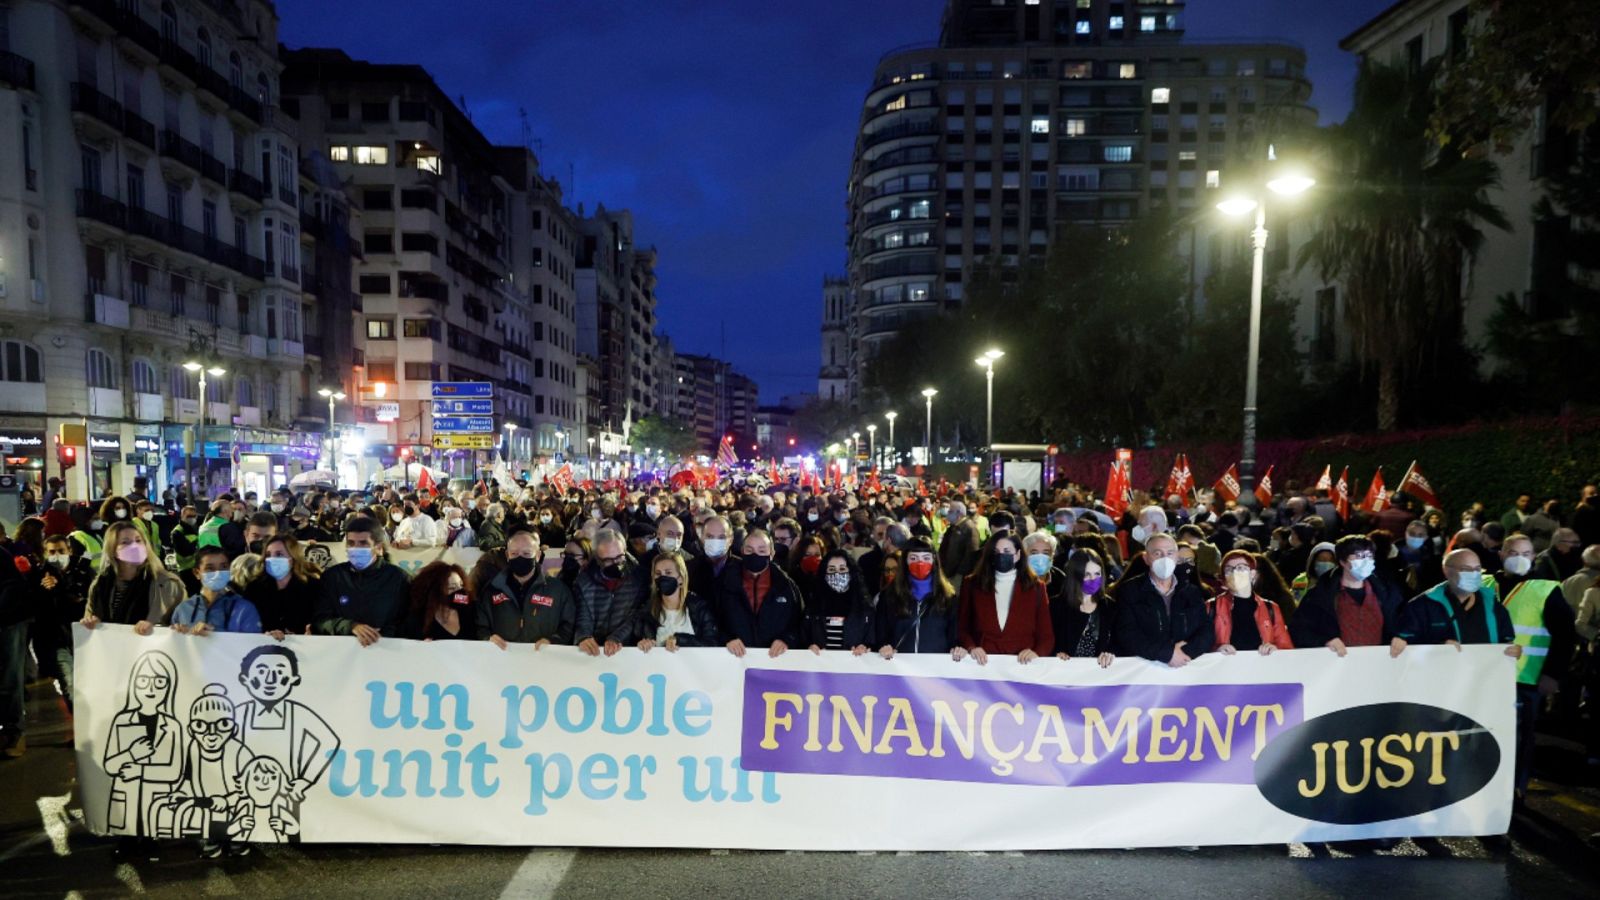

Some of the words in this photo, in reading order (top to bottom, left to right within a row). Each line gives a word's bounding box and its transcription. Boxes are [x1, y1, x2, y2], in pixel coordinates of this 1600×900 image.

[365, 680, 474, 731] un
[500, 672, 713, 749] poble
[759, 691, 1284, 776] FINANÇAMENT
[325, 733, 501, 798] unit
[524, 752, 657, 815] per
[1298, 731, 1460, 798] JUST
